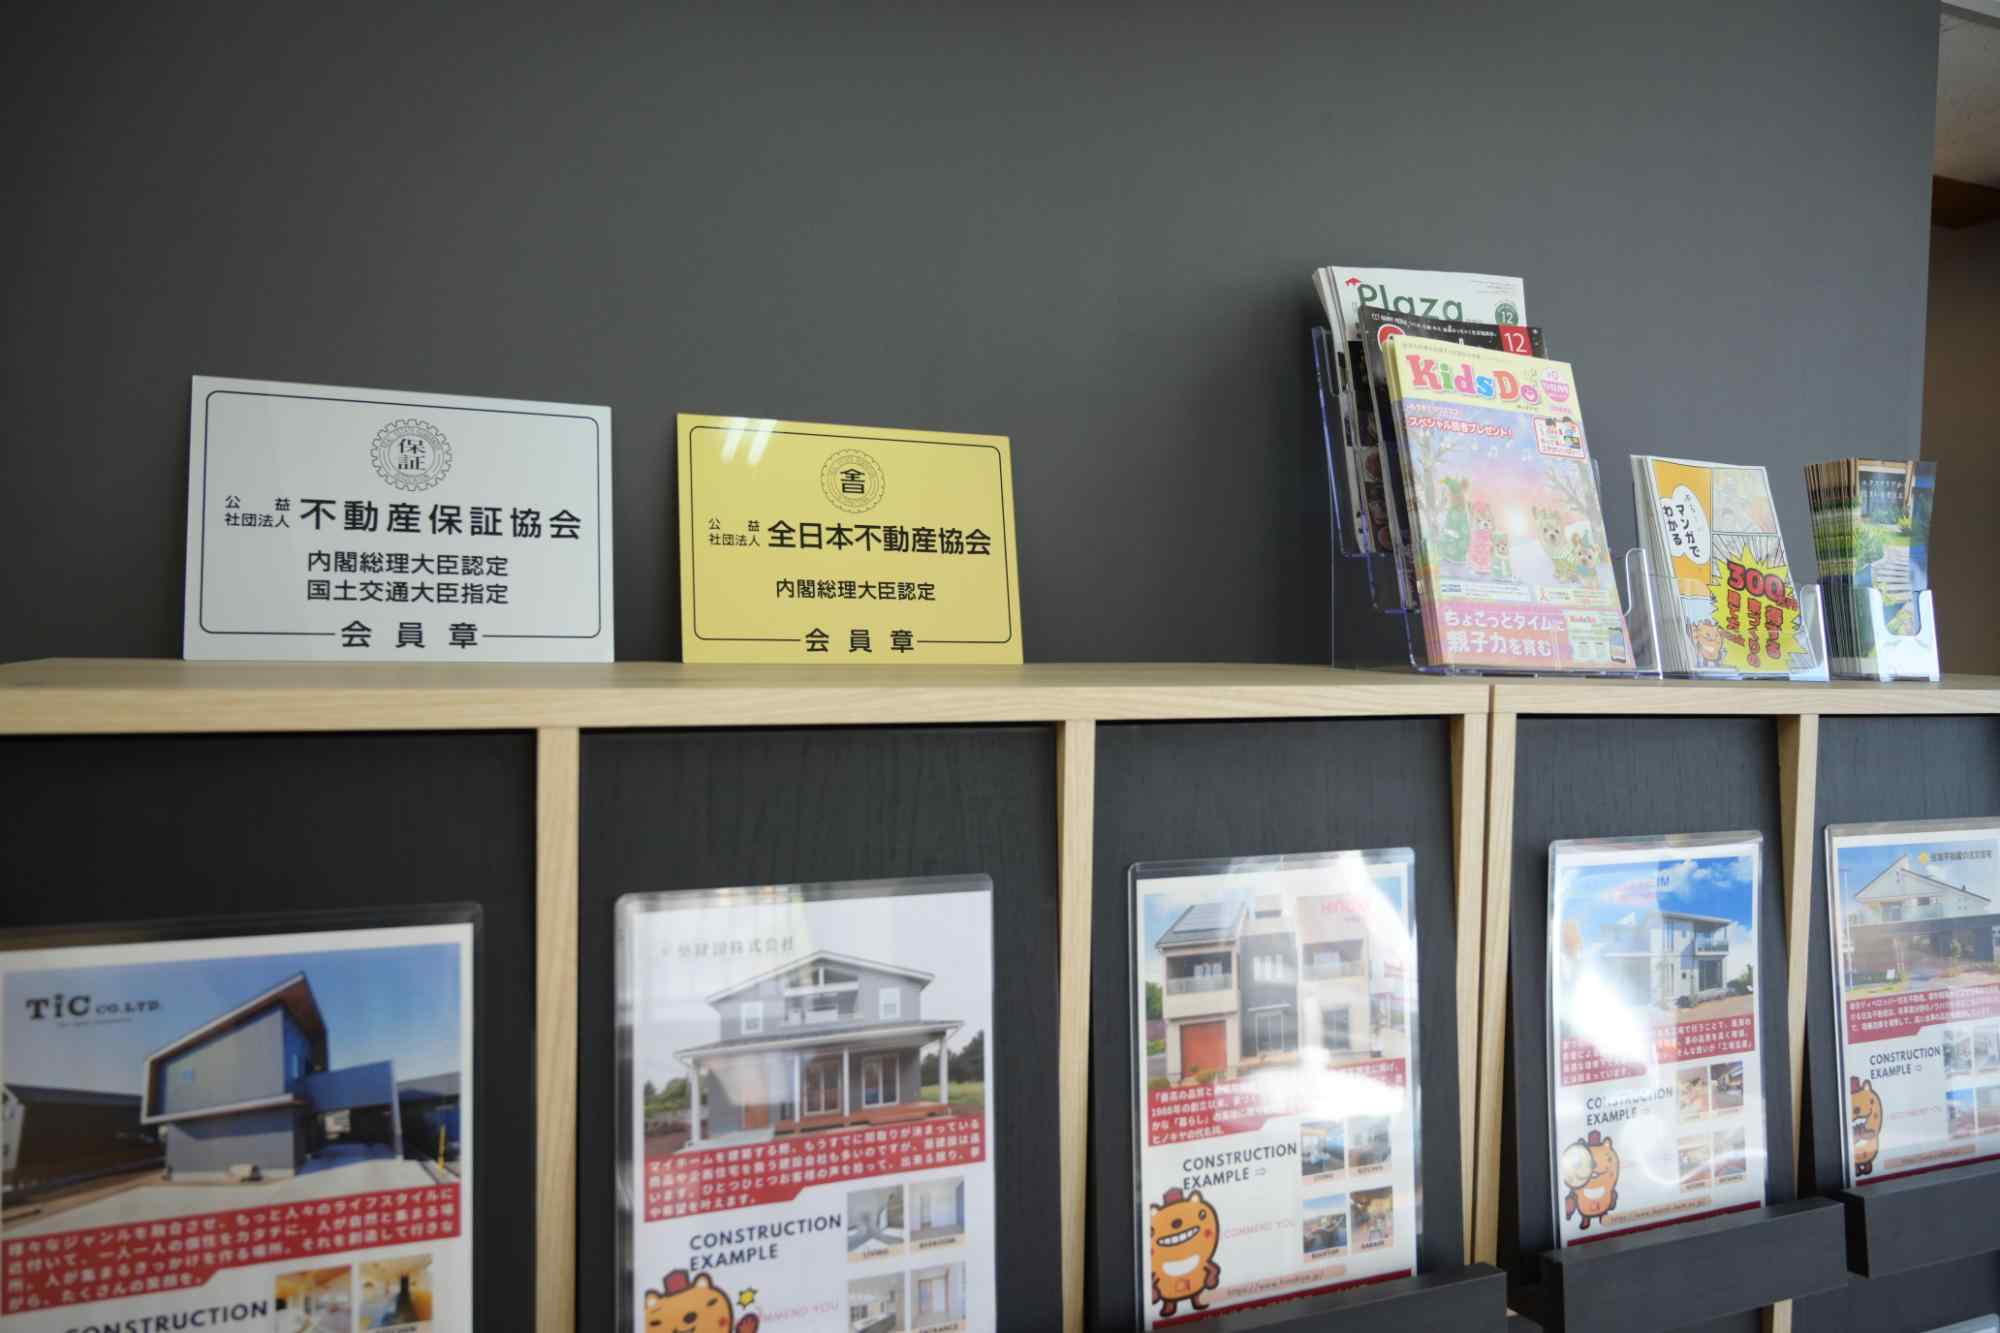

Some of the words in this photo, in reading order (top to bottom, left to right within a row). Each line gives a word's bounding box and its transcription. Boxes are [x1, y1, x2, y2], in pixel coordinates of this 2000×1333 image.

[1504, 332, 1527, 353] 12
[398, 438, 427, 471] 保証
[224, 512, 291, 529] 社団法人
[300, 498, 582, 540] 不動産保証協会
[708, 533, 761, 547] 社団法人
[767, 519, 991, 556] 全日本不動産協会
[307, 550, 509, 577] 内閣総理大臣認定
[306, 579, 509, 605] 国土交通大臣指定
[776, 578, 937, 602] 内閣総理大臣認定
[1868, 1045, 1942, 1067] CONSTRUCTION
[1869, 1063, 1912, 1081] EXAMPLE
[1183, 1142, 1298, 1173] CONSTRUCTION
[1183, 1167, 1250, 1191] EXAMPLE
[689, 1214, 842, 1250] CONSTRUCTION
[689, 1243, 779, 1272] EXAMPLE
